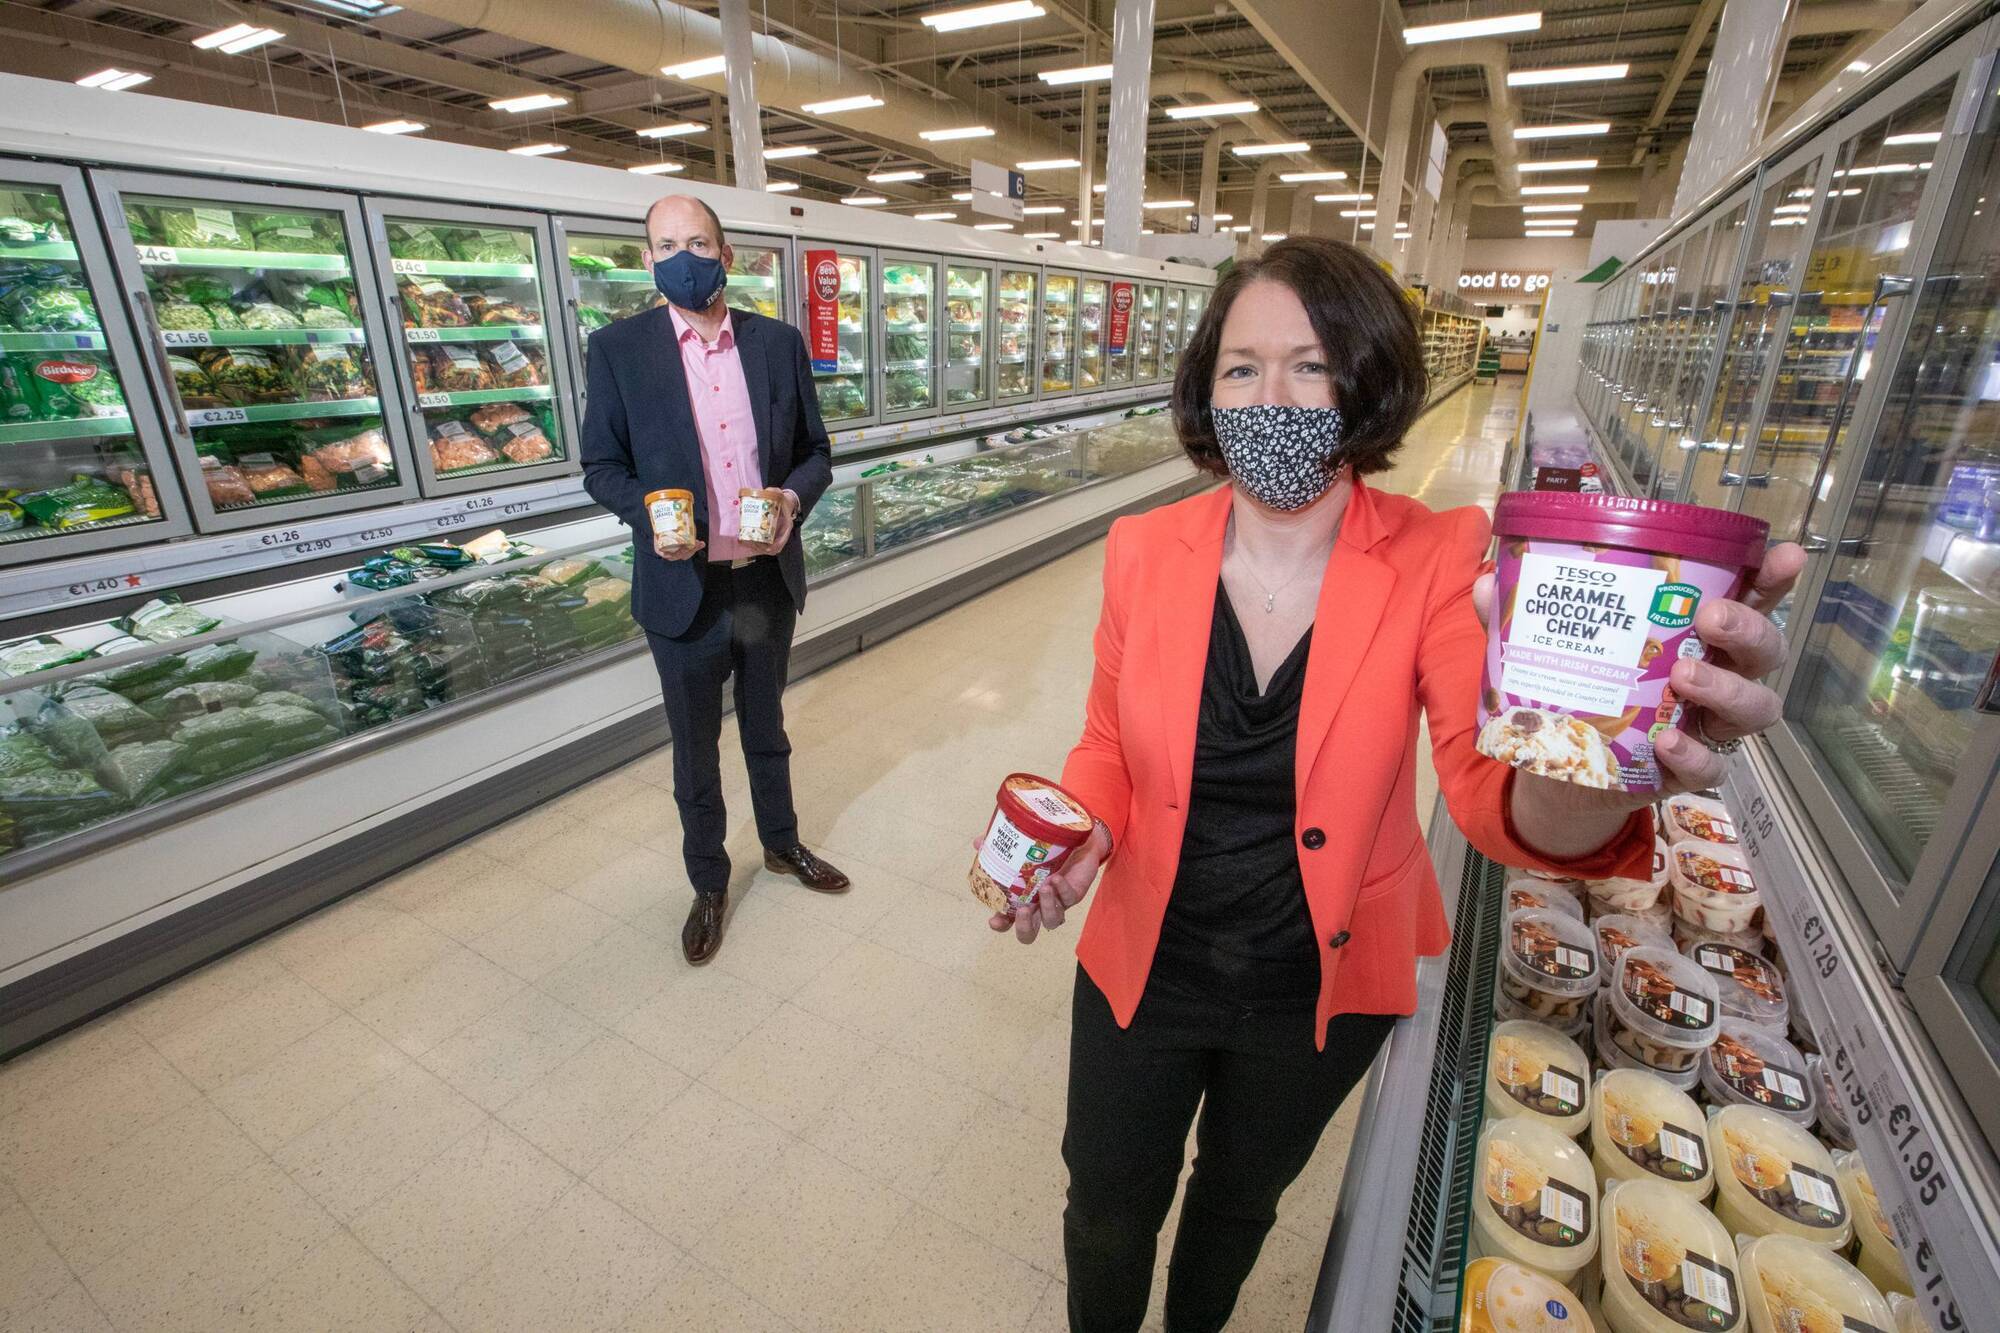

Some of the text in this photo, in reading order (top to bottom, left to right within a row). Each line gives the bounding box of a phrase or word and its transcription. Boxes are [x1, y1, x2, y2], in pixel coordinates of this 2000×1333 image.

[1016, 177, 1024, 196] 6
[394, 261, 423, 273] 84c
[818, 276, 837, 285] Value
[1458, 271, 1550, 292] ood to go
[164, 332, 208, 344] €1.56
[407, 330, 437, 340] €1.50
[203, 409, 245, 422] €2.25
[1546, 476, 1569, 484] PARTY
[466, 497, 494, 510] €1.26
[504, 502, 531, 515] €1.72
[437, 514, 466, 527] €2.50
[261, 530, 300, 545] €1.26
[360, 527, 393, 541] €2.50
[295, 539, 332, 554] €2.90
[1556, 565, 1617, 583] TESCO
[69, 577, 119, 596] €1.40
[1658, 585, 1695, 594] PRODUCED
[1536, 583, 1626, 611] CARAMEL
[1525, 599, 1637, 631] CHOCOLATE
[1649, 612, 1690, 625] IRELAND
[1546, 618, 1600, 640] CHEW
[1533, 634, 1605, 655] ICE CREAM
[1509, 648, 1630, 680] MADE WITH IRISH CREAM
[1750, 798, 1773, 839] €7.30
[997, 828, 1019, 849] WAFFLE
[997, 836, 1012, 852] CONE
[992, 839, 1013, 860] CRUNCH
[1804, 915, 1838, 979] €7.29
[1889, 1104, 1947, 1206] €1.95
[1916, 1237, 1966, 1333] €1.9
